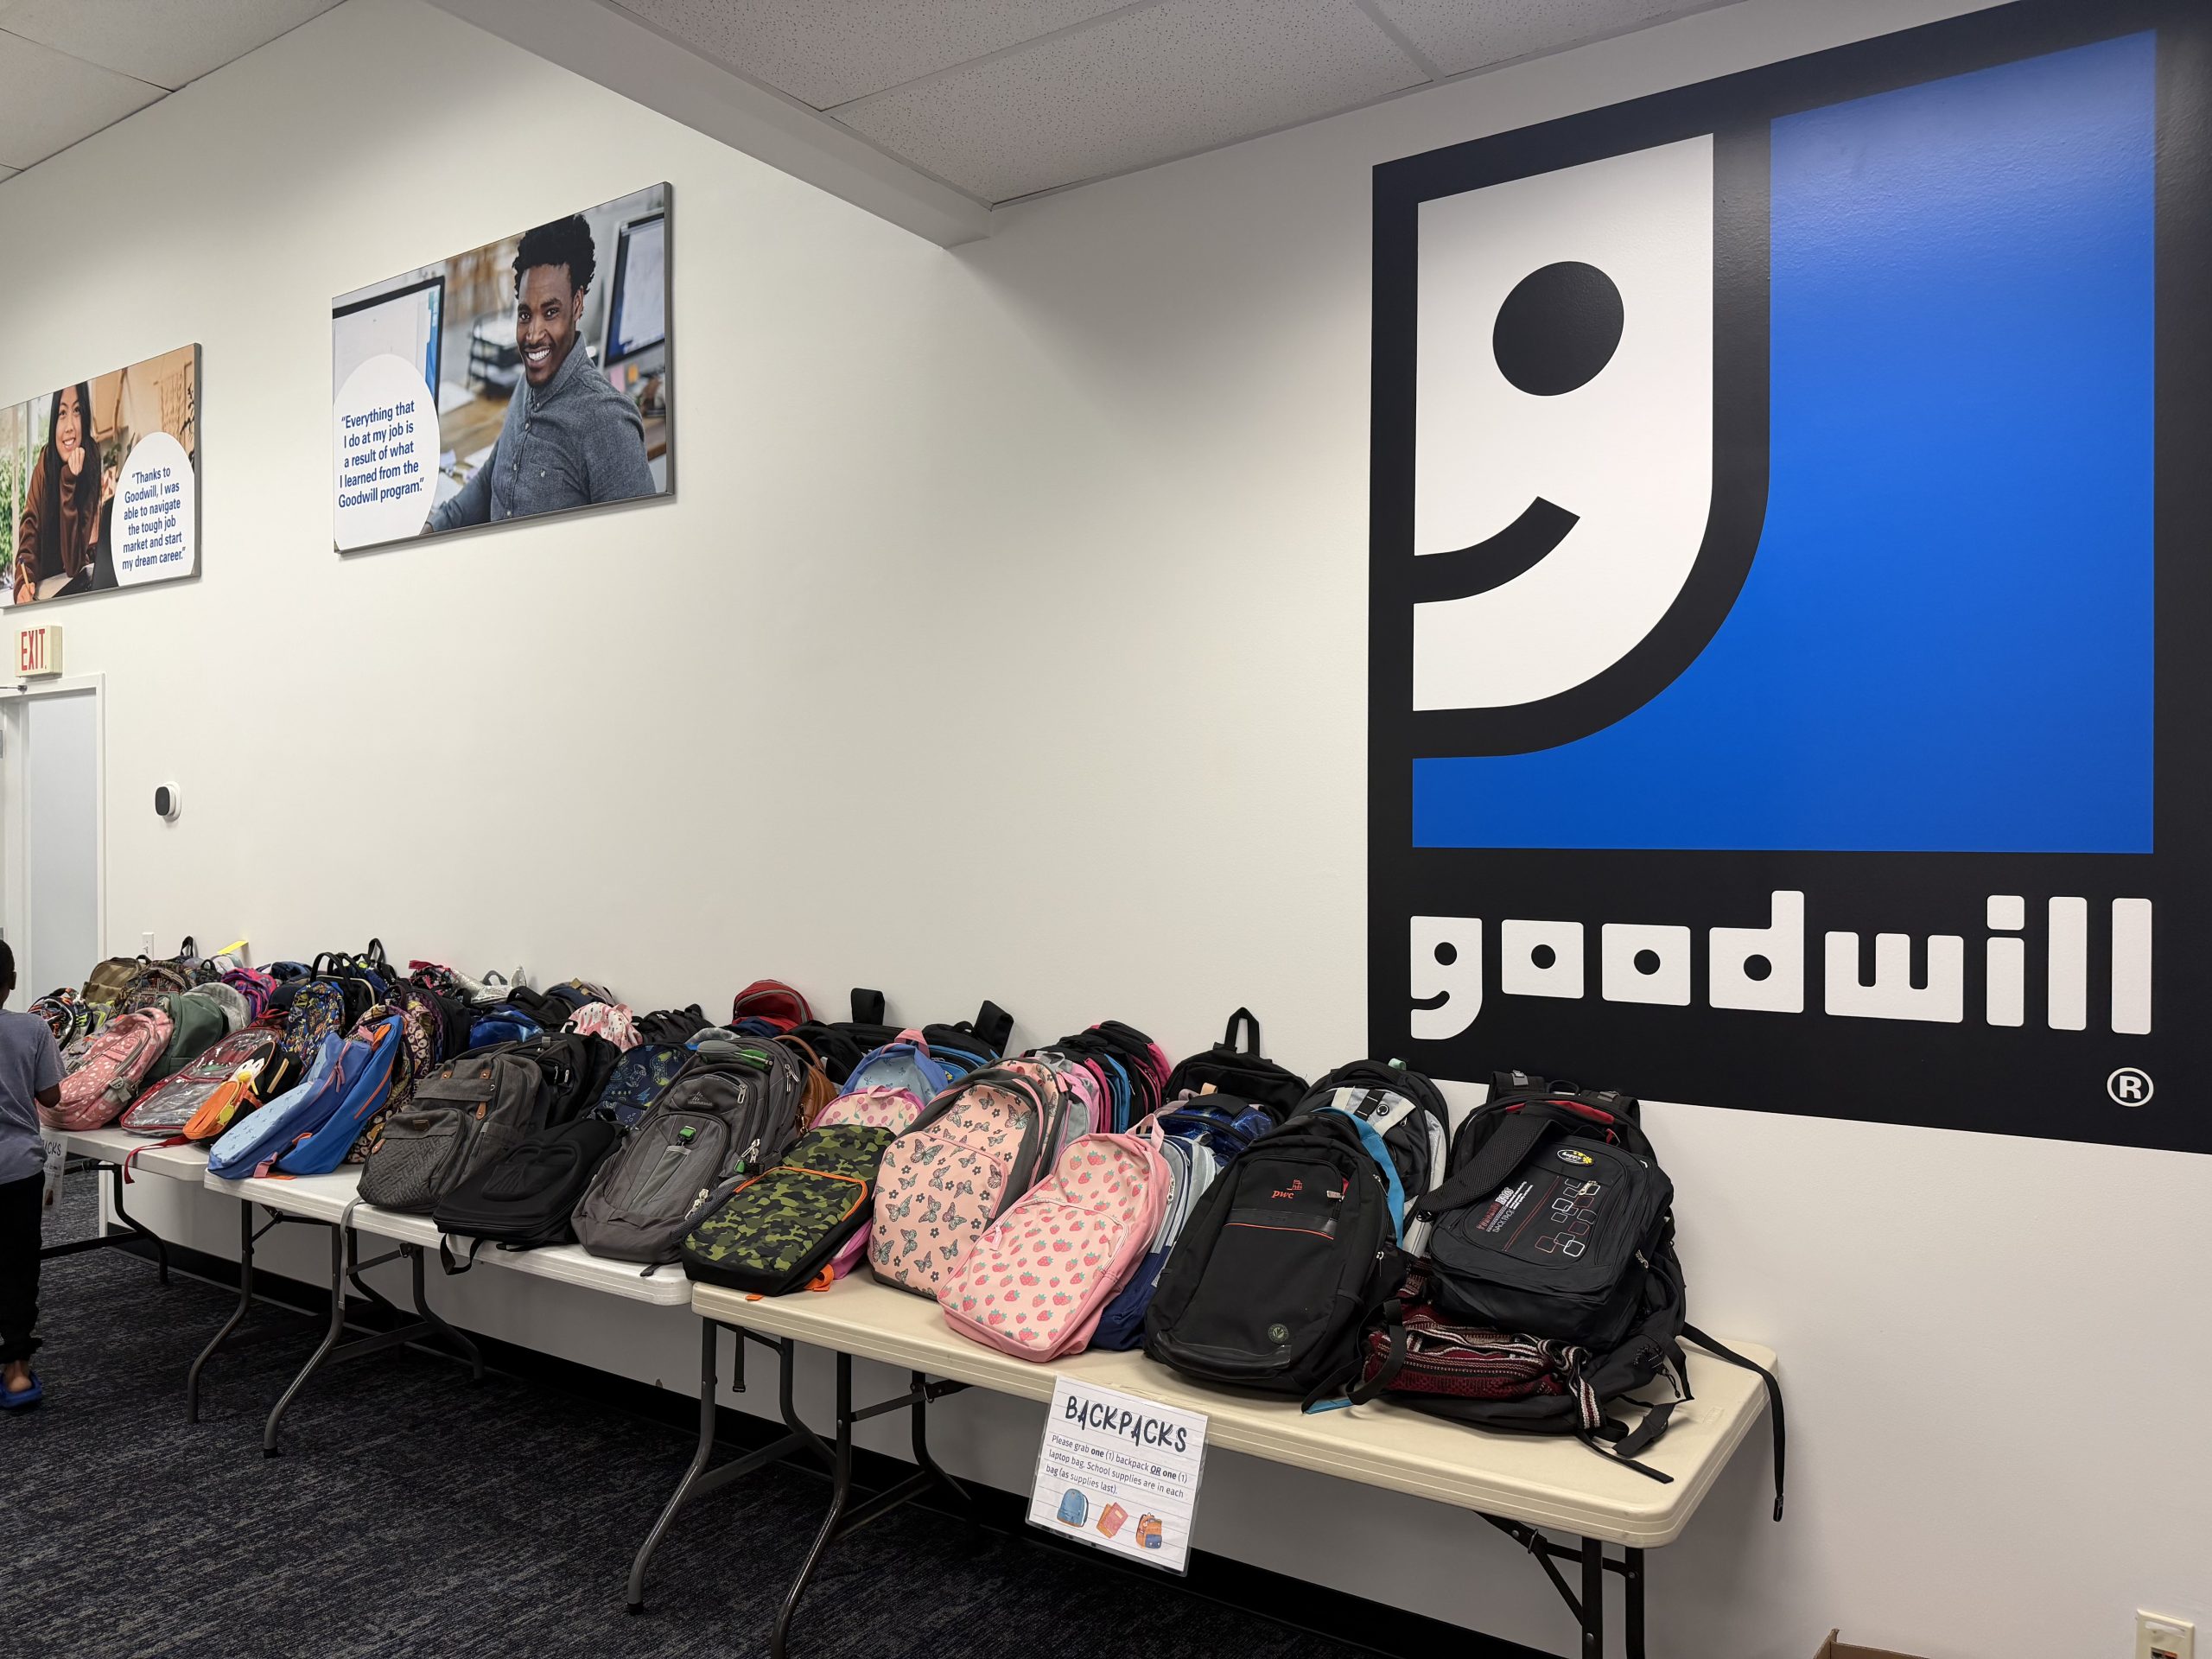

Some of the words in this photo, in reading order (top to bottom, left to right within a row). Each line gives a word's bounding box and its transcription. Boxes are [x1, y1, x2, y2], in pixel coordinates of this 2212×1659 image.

[396, 400, 415, 416] that
[349, 433, 360, 448] do
[362, 432, 371, 445] at
[373, 429, 387, 442] my
[389, 423, 404, 442] job
[406, 421, 414, 434] is
[345, 457, 350, 467] a
[352, 449, 377, 467] result
[378, 446, 388, 461] of
[390, 441, 415, 458] what
[163, 467, 171, 478] to
[345, 468, 377, 487] learned
[379, 466, 401, 478] from
[404, 461, 419, 474] the
[125, 485, 159, 504] Goodwill,
[165, 483, 180, 493] was
[339, 487, 378, 508] Goodwill
[124, 506, 138, 520] able
[141, 506, 148, 517] to
[149, 499, 181, 514] navigate
[129, 524, 140, 537] the
[142, 518, 162, 533] tough
[164, 515, 176, 531] job
[124, 539, 148, 554] market
[150, 534, 163, 549] and
[165, 532, 182, 545] start
[122, 559, 133, 571] my
[136, 556, 157, 568] dream
[22, 629, 45, 671] EXIT
[1410, 890, 2152, 1040] goodwill
[1271, 1190, 1294, 1199] pwc
[1065, 1395, 1187, 1452] BACKPACKS
[1052, 1434, 1073, 1448] Please
[1074, 1442, 1090, 1455] grab
[1091, 1446, 1104, 1458] one
[1105, 1448, 1115, 1461] (1)
[1116, 1454, 1149, 1473] backpack
[1150, 1465, 1161, 1476] OR
[1162, 1470, 1177, 1480] one
[1178, 1471, 1188, 1484] (1)
[1046, 1465, 1058, 1477] bag
[1059, 1468, 1069, 1479] (as
[1071, 1472, 1099, 1490] supplies
[1100, 1481, 1118, 1495] last).
[1049, 1449, 1071, 1465] laptop
[1071, 1456, 1085, 1470] bag.
[1087, 1461, 1111, 1477] School
[1112, 1470, 1141, 1487] supplies
[1144, 1479, 1156, 1491] are
[1158, 1483, 1164, 1492] in
[1166, 1485, 1184, 1498] each
